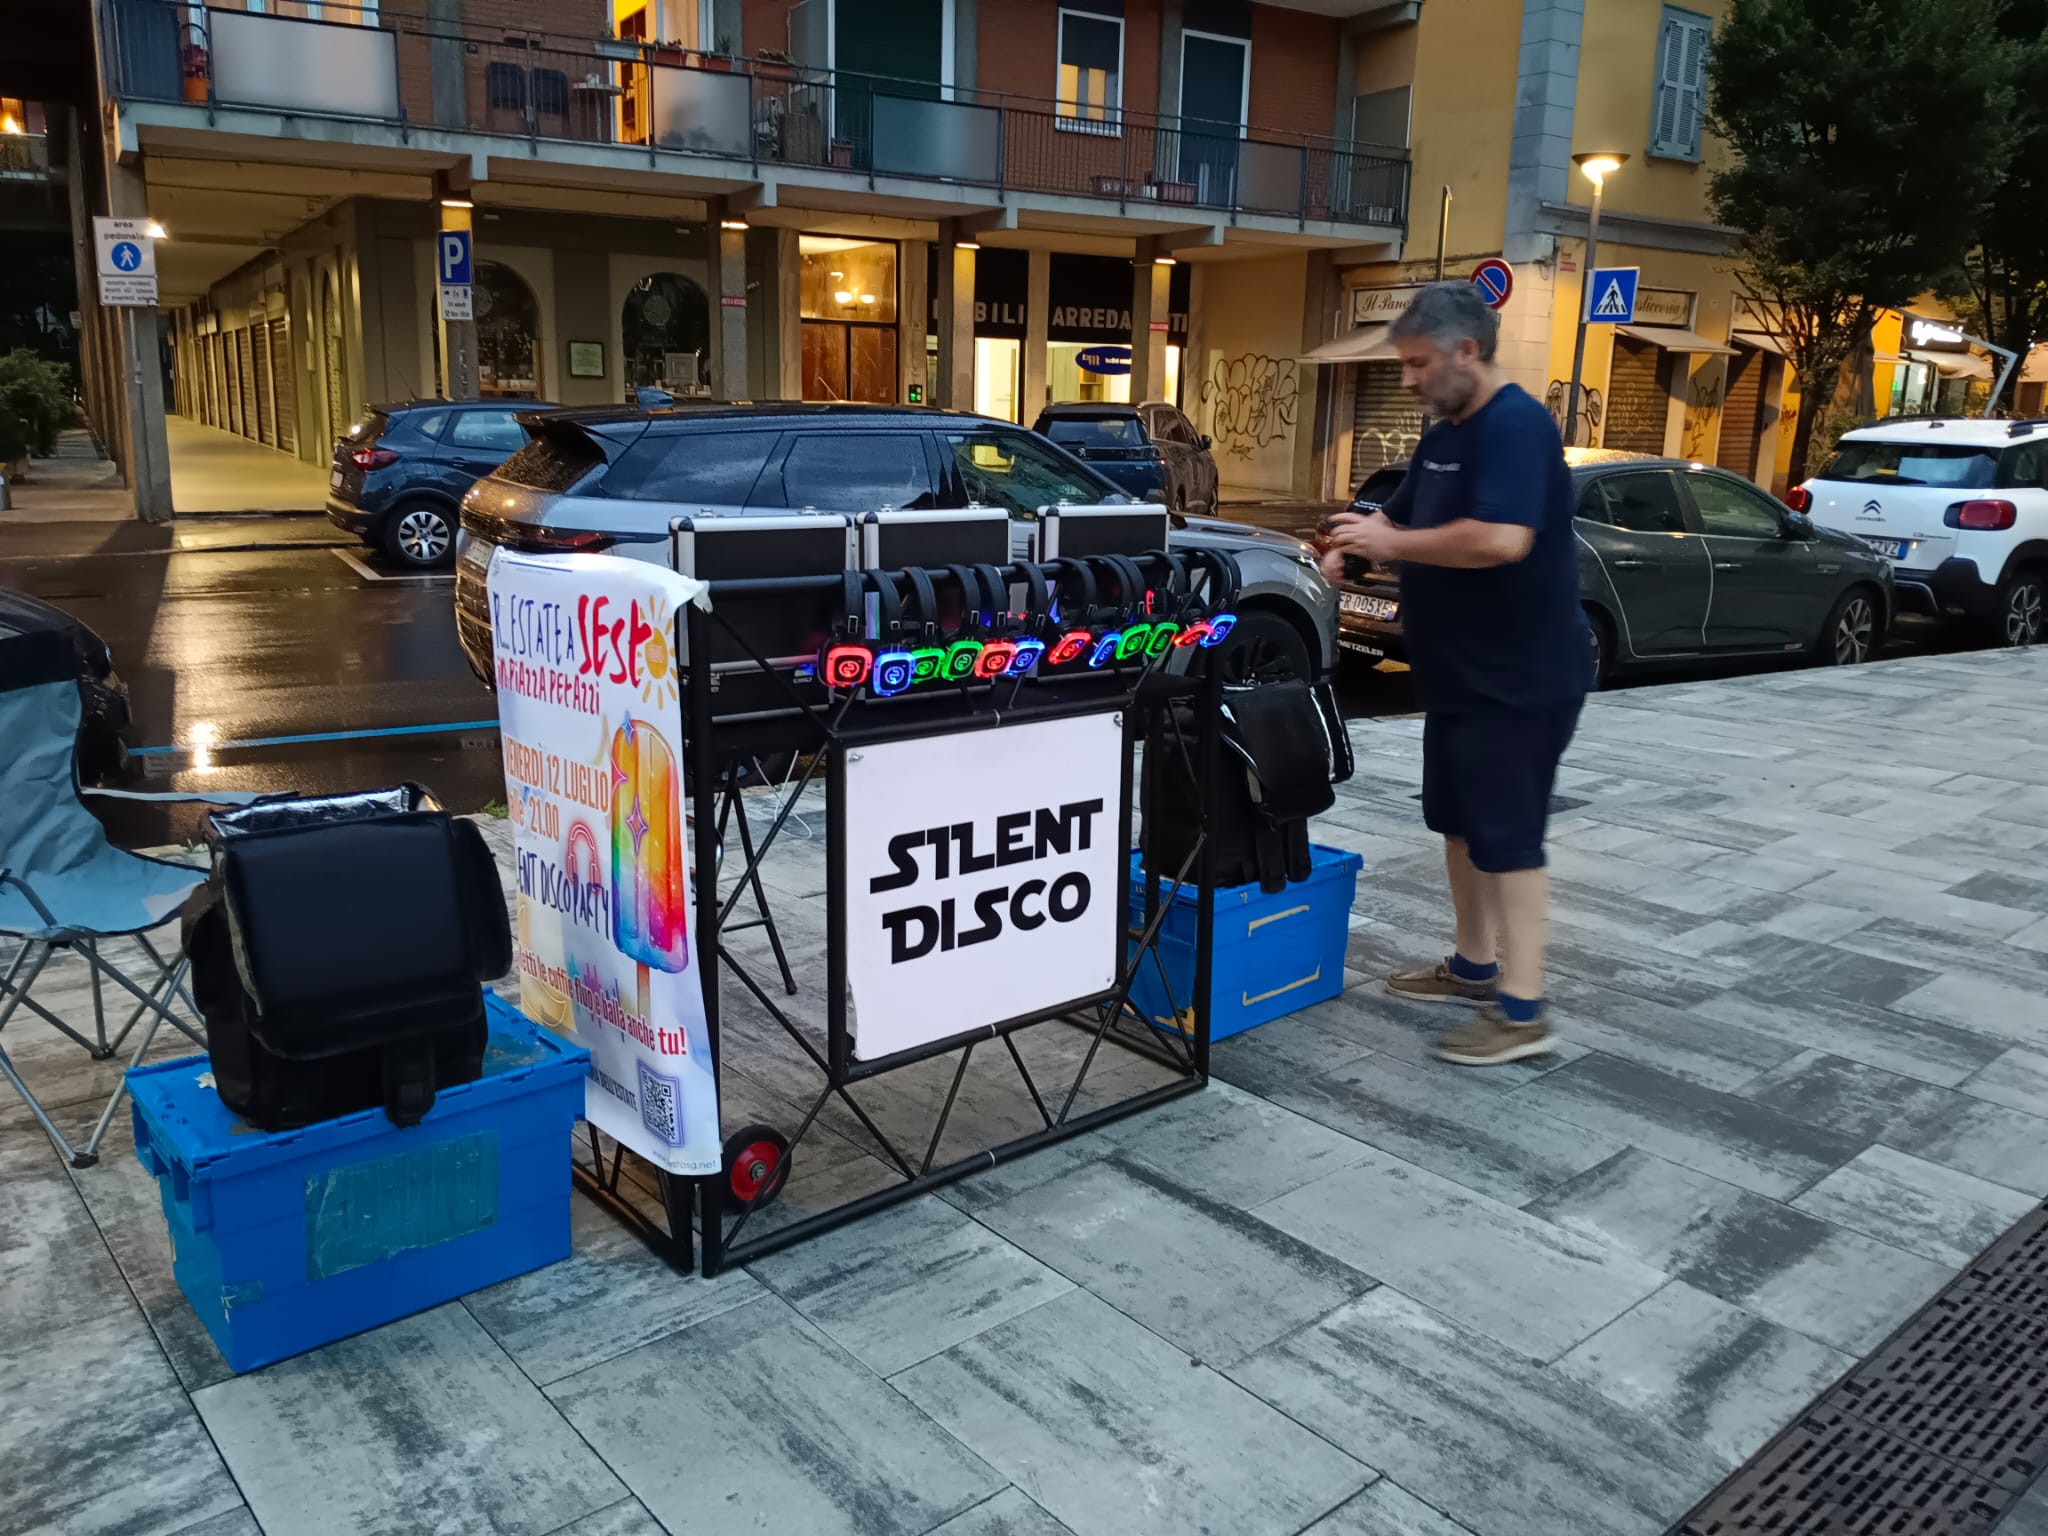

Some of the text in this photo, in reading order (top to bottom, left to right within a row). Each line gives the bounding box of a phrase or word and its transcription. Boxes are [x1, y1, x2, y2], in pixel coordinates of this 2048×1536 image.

[104, 232, 145, 240] pedonale
[444, 237, 464, 279] P
[547, 754, 561, 795] 12
[564, 758, 609, 813] LUGLIO
[529, 795, 560, 841] 21.00
[870, 797, 1104, 895] SILENT
[540, 859, 571, 913] DISCO
[573, 872, 609, 940] PARTY
[882, 871, 1092, 965] DISCO
[602, 990, 626, 1031] balla
[627, 1014, 656, 1051] anche
[658, 1026, 687, 1055] tu!
